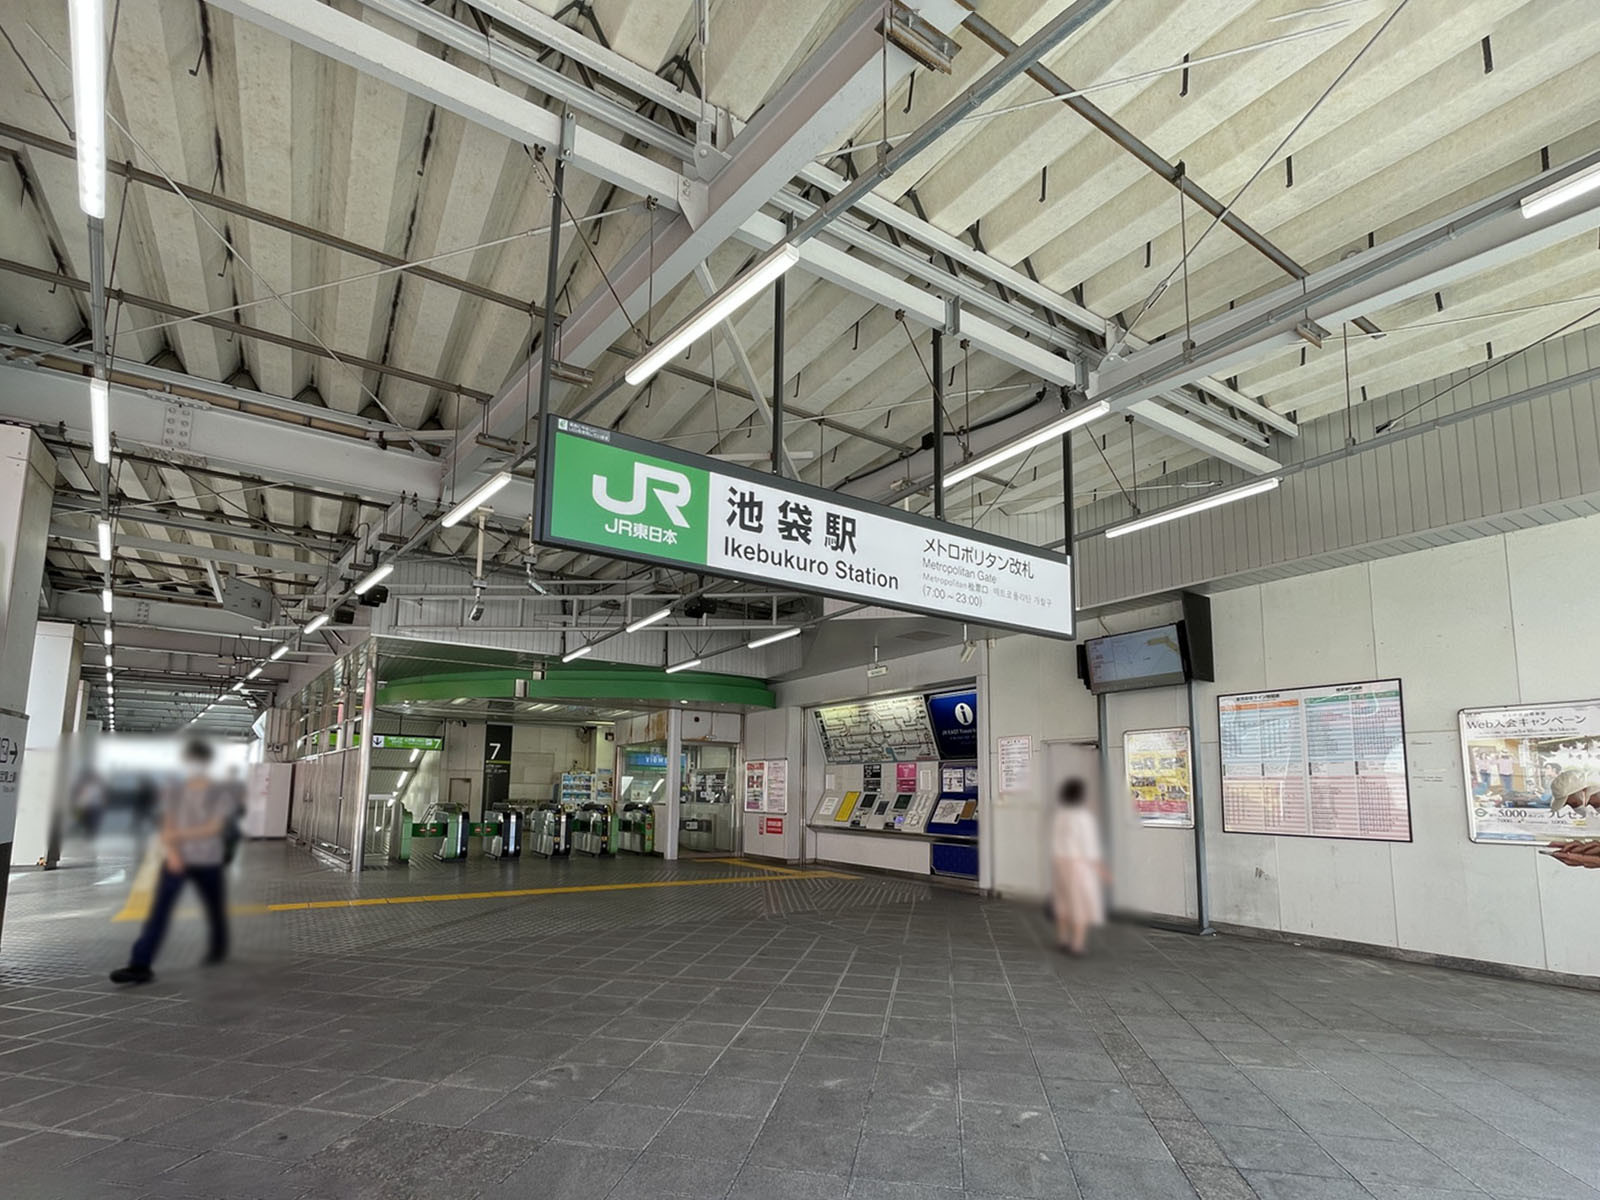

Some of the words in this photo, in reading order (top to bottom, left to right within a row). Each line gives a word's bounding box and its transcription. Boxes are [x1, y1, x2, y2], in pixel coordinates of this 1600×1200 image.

[592, 461, 691, 528] JR
[604, 518, 678, 545] JR東日本
[726, 486, 857, 555] 池袋駅
[724, 536, 829, 576] Ikebukuro
[835, 564, 899, 591] Station
[922, 557, 976, 579] Metropolitan
[977, 570, 997, 585] Gate
[923, 538, 1035, 580] メトロポリタン改札
[1466, 715, 1587, 730] Web入会キャンペーン
[433, 738, 442, 750] 7
[489, 742, 502, 760] 7
